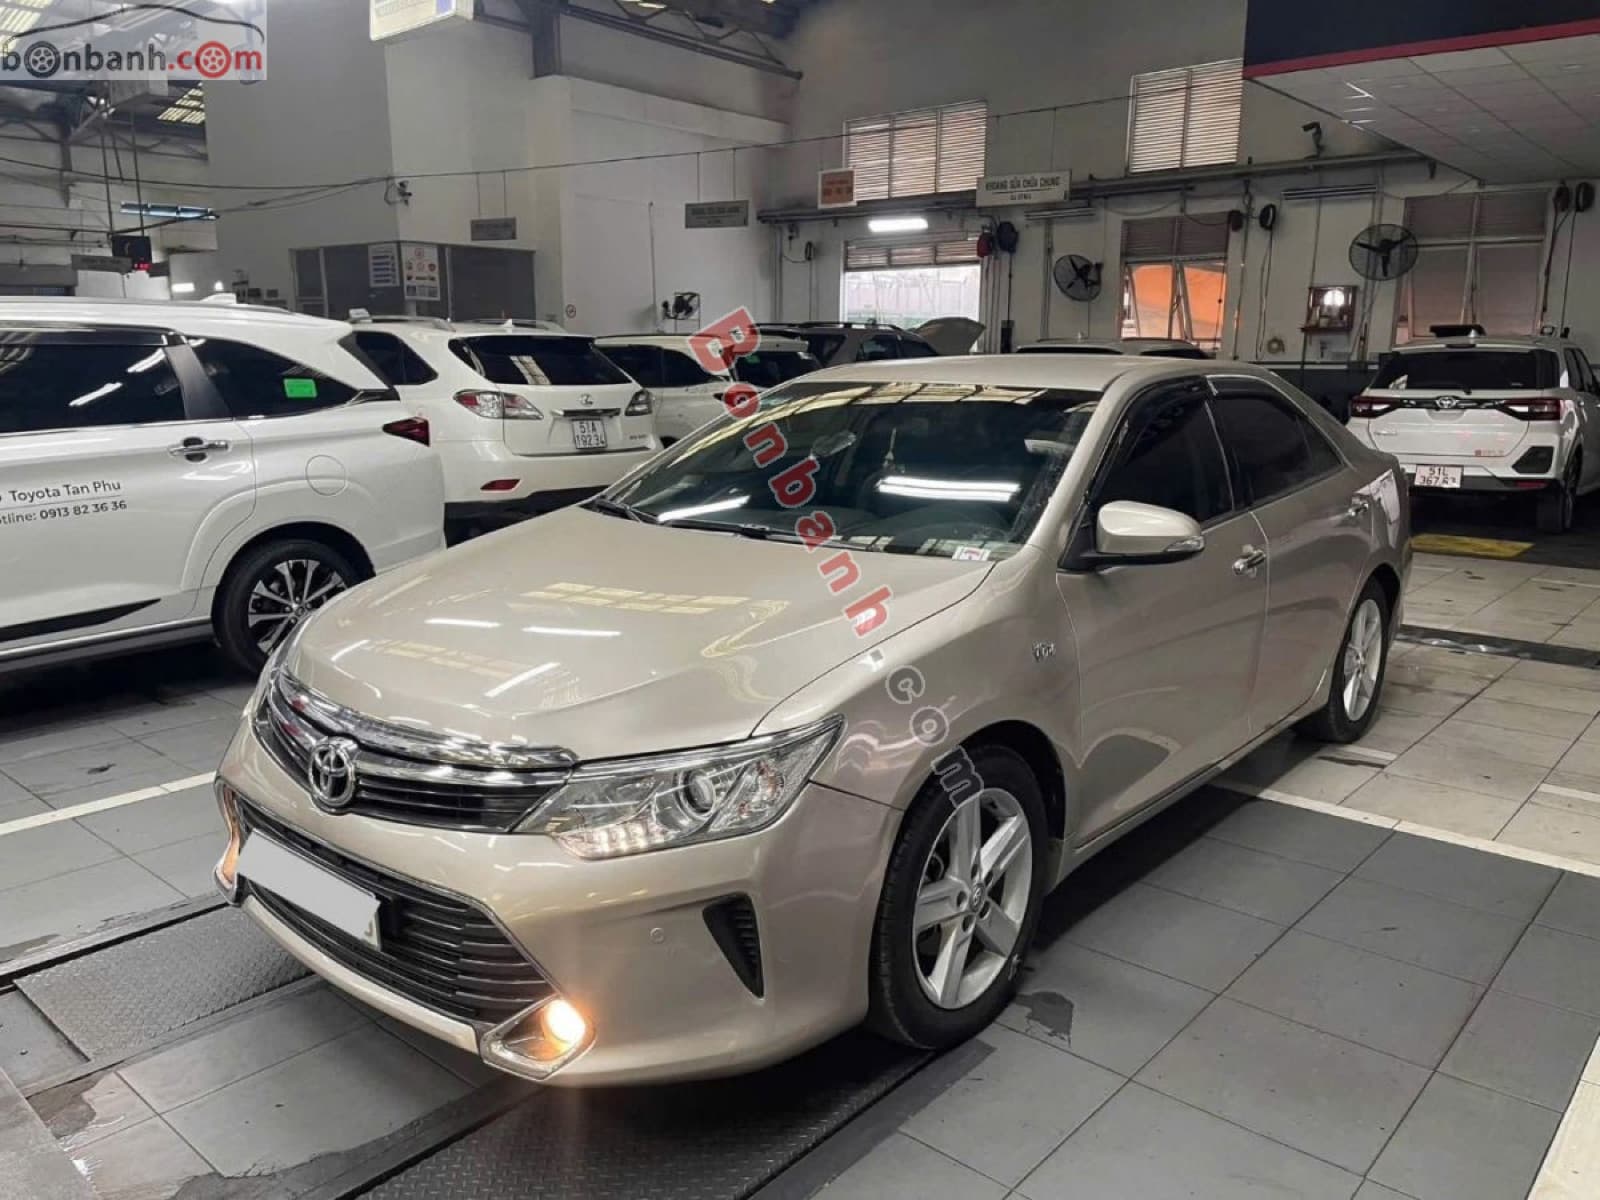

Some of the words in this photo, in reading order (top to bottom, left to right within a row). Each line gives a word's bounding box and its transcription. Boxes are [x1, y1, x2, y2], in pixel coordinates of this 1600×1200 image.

[8, 488, 61, 503] Toyota
[62, 484, 90, 496] Tan
[92, 480, 121, 493] Phu
[39, 506, 70, 520] 0913
[72, 504, 90, 516] 82
[92, 502, 109, 513] 36
[111, 500, 128, 511] 36
